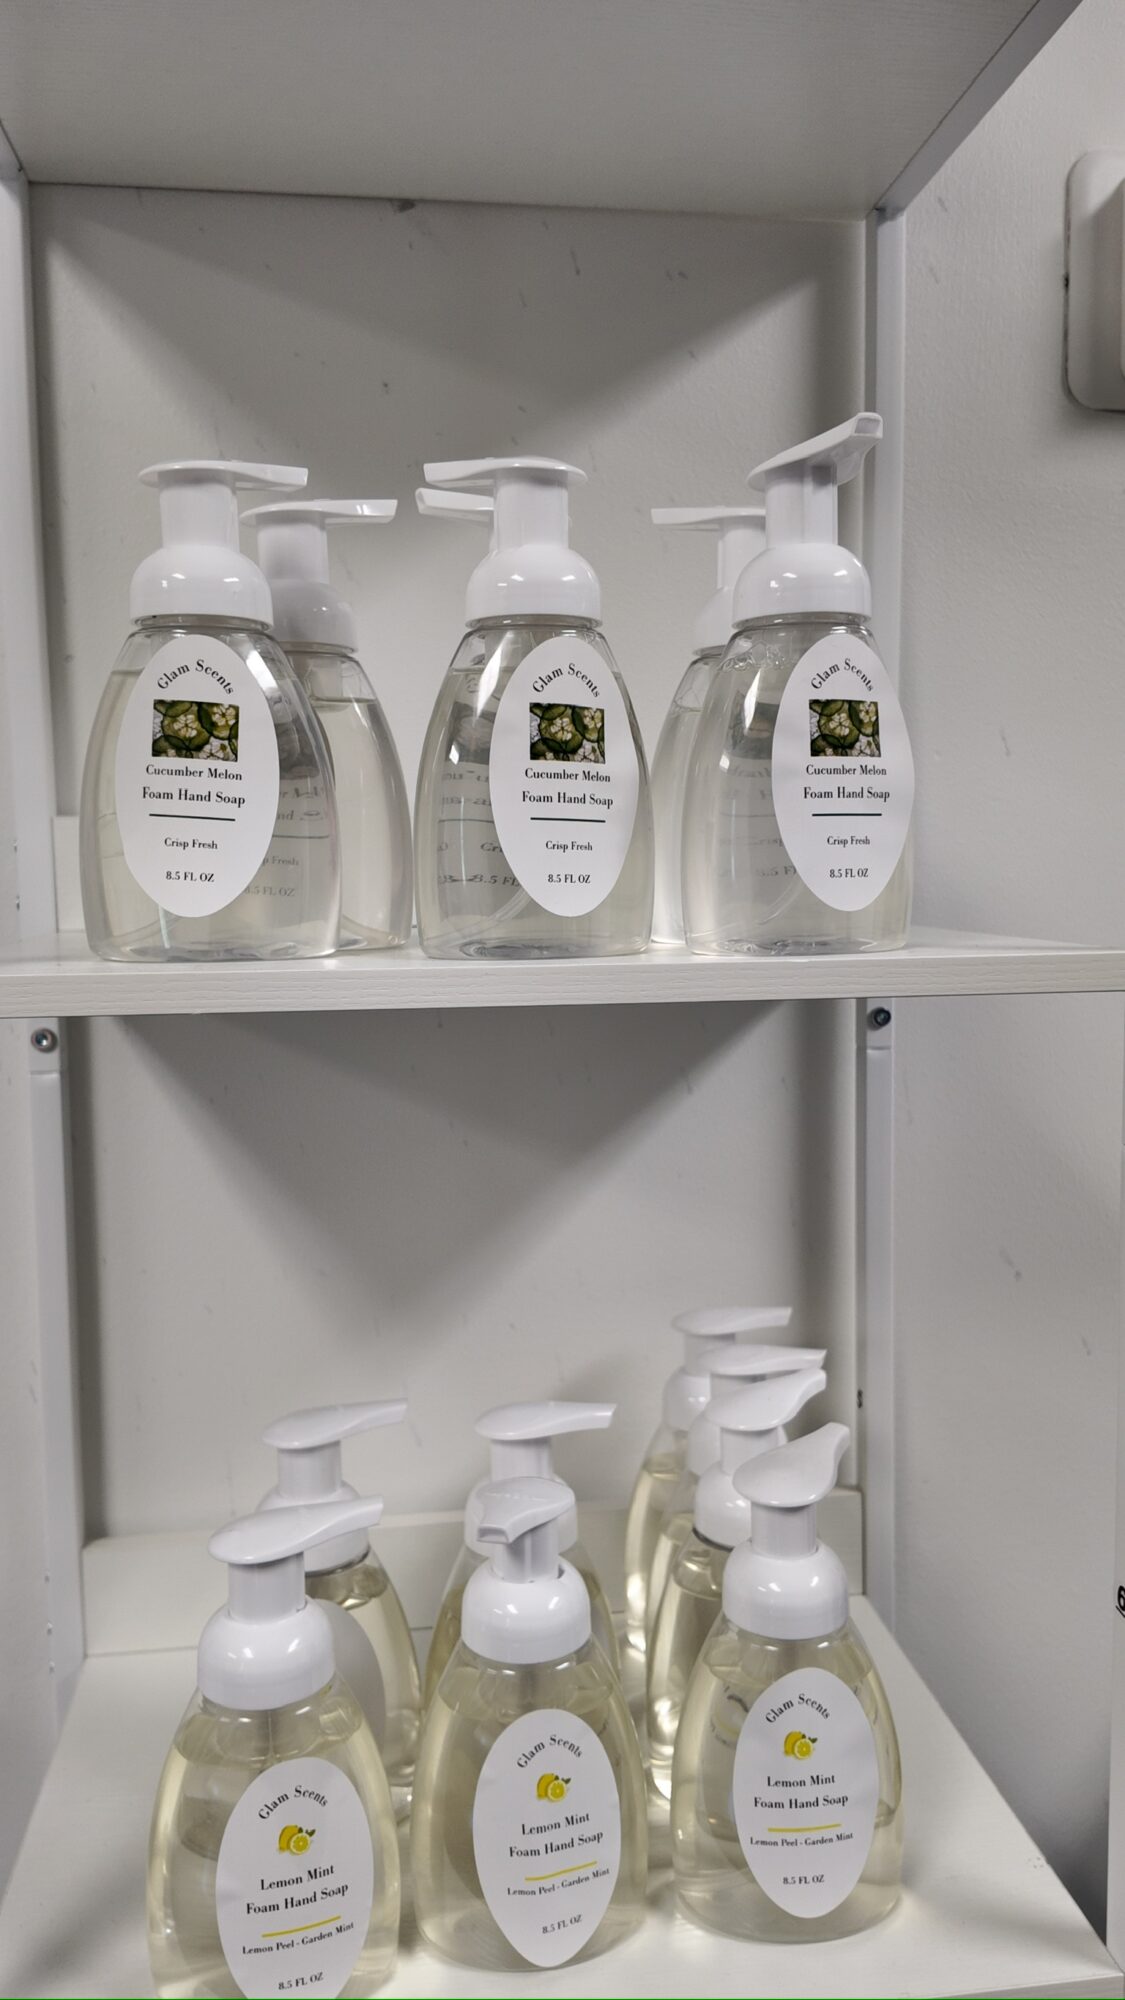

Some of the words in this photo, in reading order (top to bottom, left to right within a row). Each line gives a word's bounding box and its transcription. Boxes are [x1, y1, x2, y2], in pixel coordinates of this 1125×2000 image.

[157, 662, 190, 690] Glam
[195, 658, 234, 695] Scents
[532, 666, 564, 694] Glam
[567, 662, 600, 698] Scents
[811, 661, 840, 690] Glam
[844, 658, 873, 692] Scents
[146, 764, 204, 778] Cucumber
[207, 768, 243, 781] Melon
[525, 768, 579, 781] Cucumber
[582, 770, 611, 783] Melon
[806, 764, 857, 776] Cucumber
[859, 765, 887, 776] Melon
[142, 787, 174, 800] Foam
[178, 788, 211, 803] Hand
[215, 792, 246, 808] Soap
[522, 791, 553, 803] Foam
[557, 792, 586, 805] Hand
[589, 793, 614, 809] Soap
[803, 787, 833, 799] Foam
[837, 786, 864, 799] Hand
[867, 787, 890, 802] Soap
[164, 837, 189, 850] Crisp
[192, 839, 218, 850] Fresh
[545, 840, 568, 853] Crisp
[571, 841, 593, 851] Fresh
[827, 836, 848, 848] Crisp
[851, 836, 870, 846] Fresh
[166, 871, 181, 881] 8.5
[184, 872, 197, 882] FL
[199, 873, 215, 883] OZ
[548, 874, 562, 883] 8.5
[564, 874, 576, 884] FL
[578, 874, 591, 884] OZ
[830, 869, 843, 878] 8.5
[845, 868, 856, 878] FL
[857, 868, 868, 878] OZ
[765, 1699, 794, 1723] Glam
[798, 1694, 830, 1720] Scents
[517, 1740, 545, 1768] Glam
[550, 1734, 582, 1758] Scents
[767, 1776, 806, 1788] Lemon
[810, 1775, 835, 1786] Mint
[258, 1793, 289, 1820] Glam
[294, 1785, 328, 1807] Scents
[754, 1797, 784, 1808] Foam
[789, 1797, 819, 1808] Hand
[822, 1795, 848, 1806] Soap
[522, 1822, 560, 1836] Lemon
[565, 1813, 590, 1828] Mint
[509, 1847, 540, 1858] Foam
[545, 1838, 574, 1855] Hand
[578, 1831, 603, 1846] Soap
[750, 1837, 778, 1846] Lemon
[805, 1836, 834, 1846] Garden
[836, 1832, 854, 1842] Mint
[261, 1876, 303, 1891] Lemon
[307, 1865, 335, 1882] Mint
[507, 1887, 536, 1896] Lemon
[538, 1884, 555, 1896] Peel
[561, 1876, 590, 1888] Garden
[592, 1868, 610, 1879] Mint
[783, 1877, 796, 1885] 8.5
[798, 1876, 810, 1884] FL
[812, 1875, 824, 1884] OZ
[247, 1902, 280, 1915] Foam
[285, 1893, 317, 1910] Hand
[321, 1884, 349, 1900] Soap
[542, 1924, 555, 1934] 8.5
[558, 1920, 568, 1930] FL
[570, 1914, 582, 1926] OZ
[242, 1946, 273, 1955] Lemon
[276, 1940, 294, 1951] Peel
[302, 1932, 332, 1945] Garden
[336, 1922, 354, 1936] Mint
[278, 1980, 292, 1990] 8.5
[295, 1978, 308, 1988] FL
[310, 1973, 324, 1982] OZ
